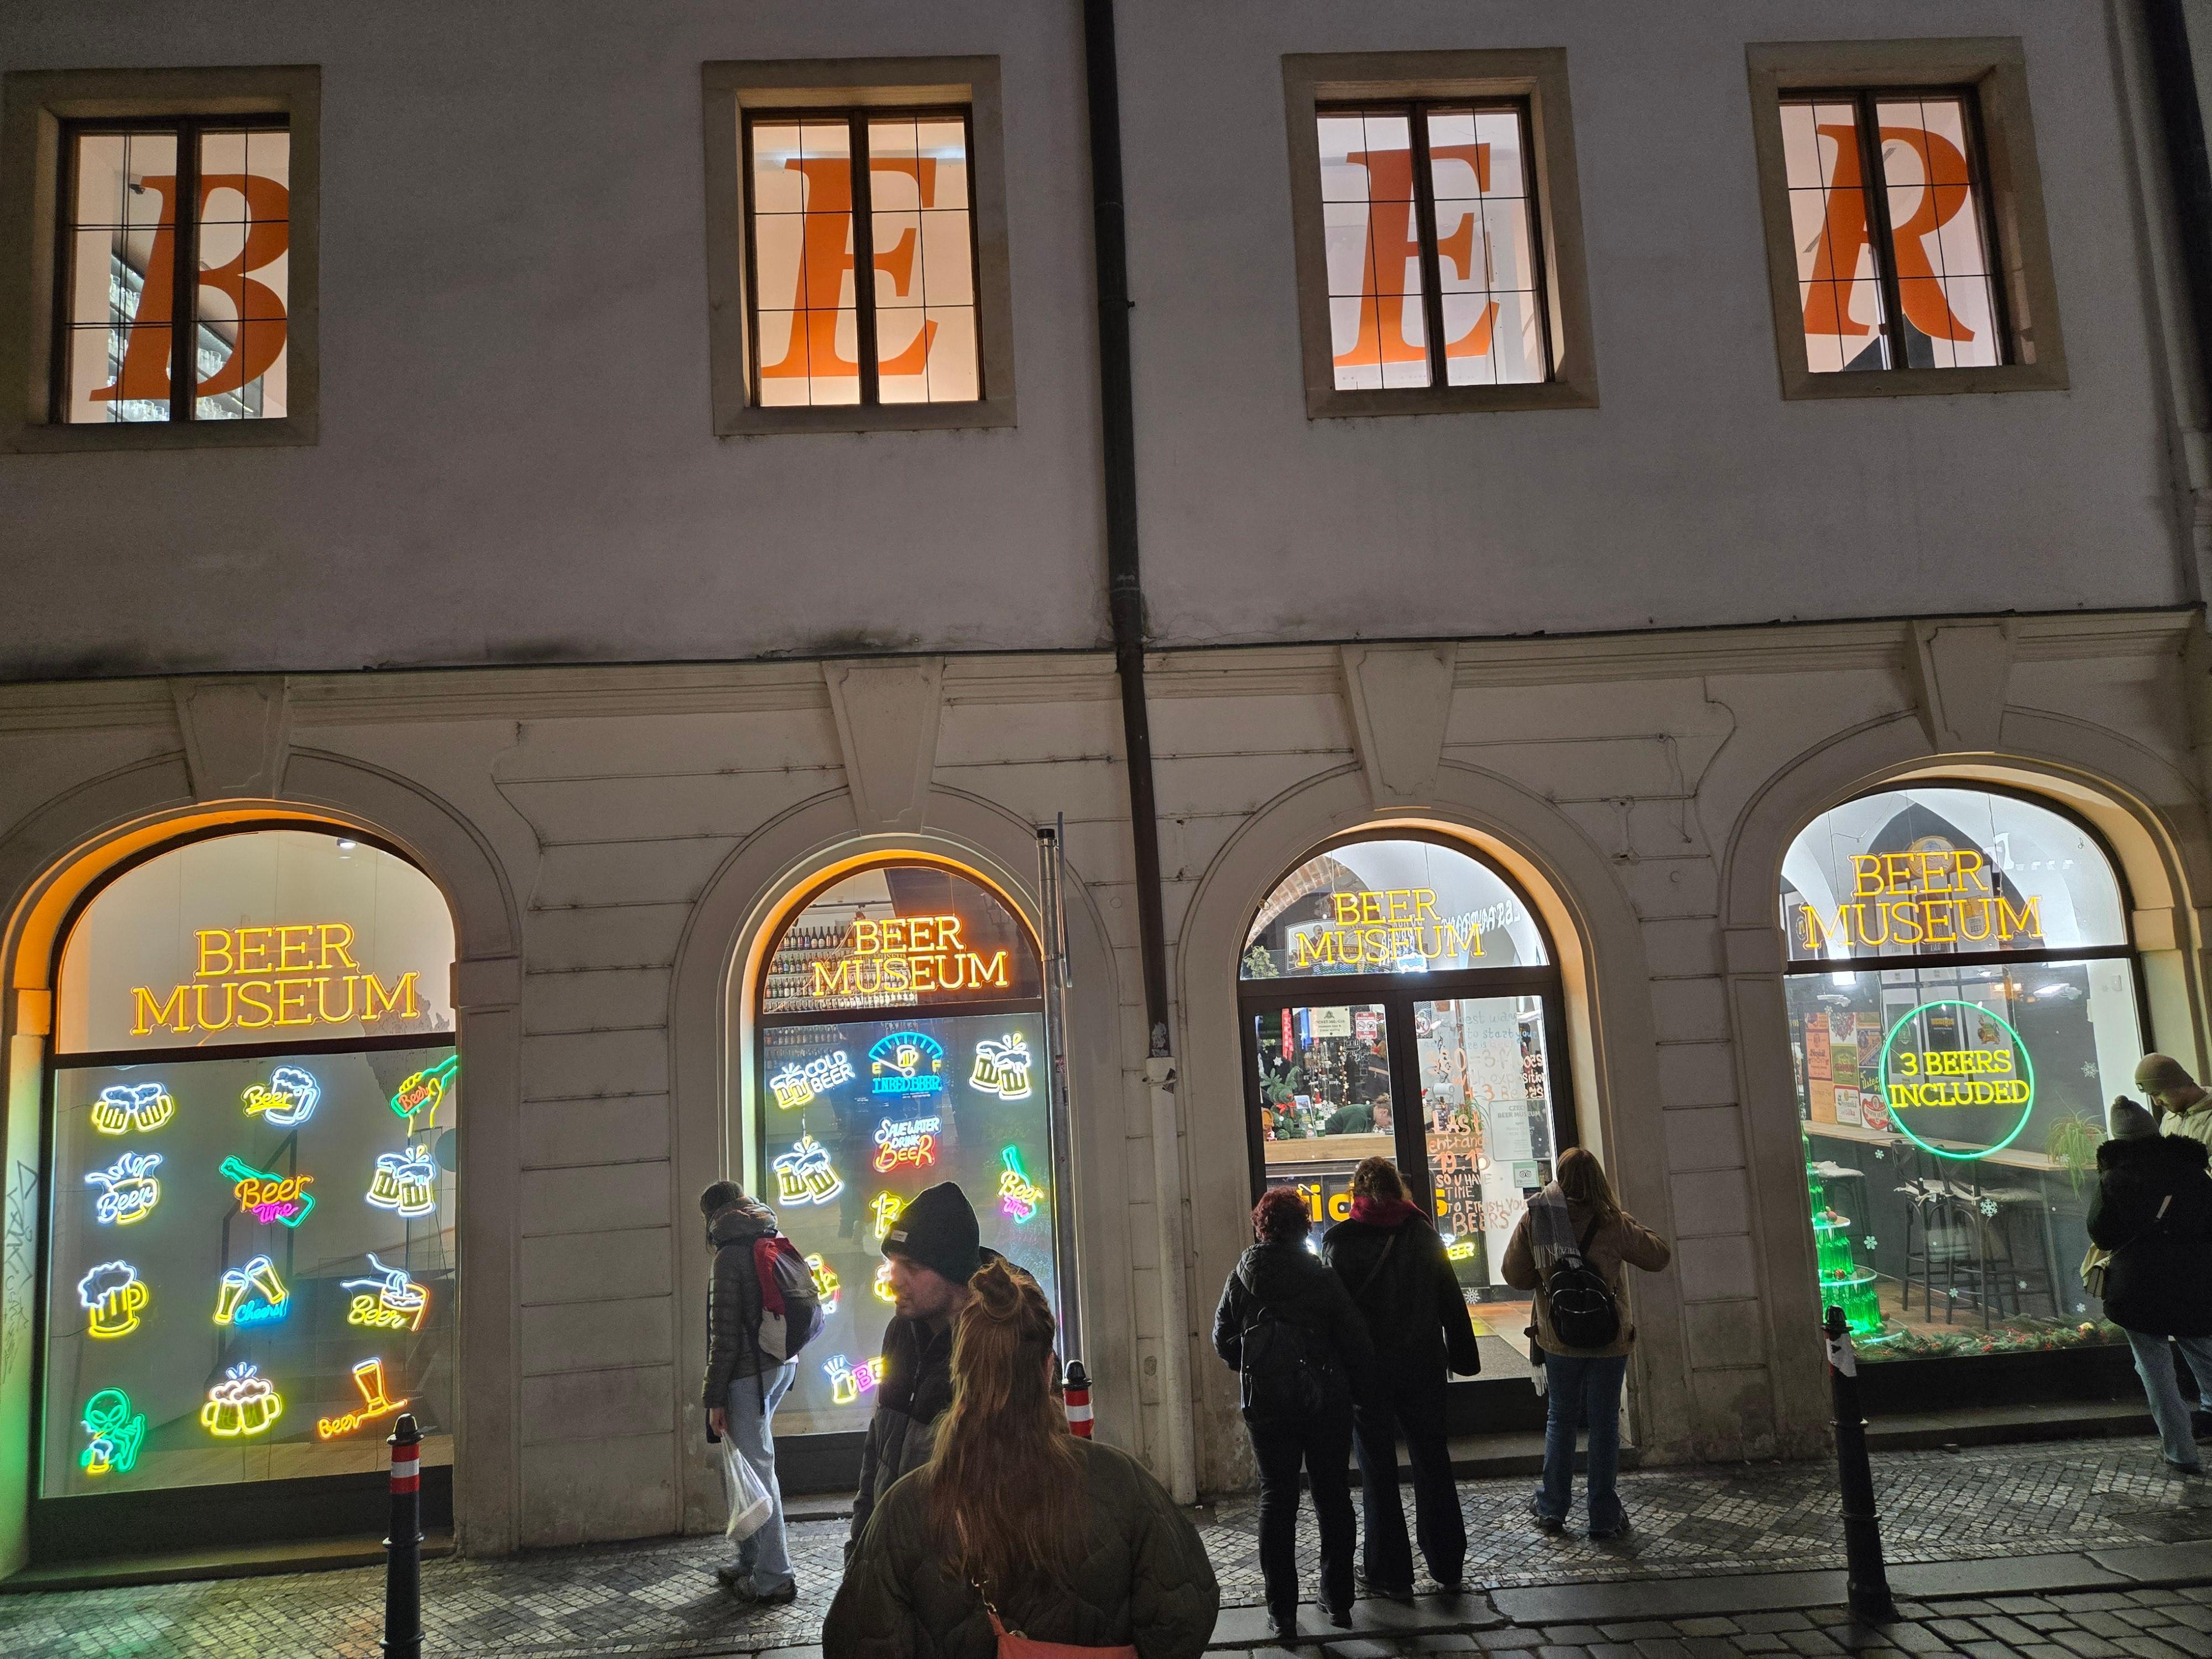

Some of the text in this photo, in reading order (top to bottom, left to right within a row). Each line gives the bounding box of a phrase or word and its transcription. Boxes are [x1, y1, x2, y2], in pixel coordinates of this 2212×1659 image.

[89, 124, 1975, 401] B E E R
[1848, 851, 1989, 897] BEER
[1333, 888, 1441, 927] BEER
[1801, 895, 2046, 948] MUSEUM
[195, 924, 357, 977] BEER
[853, 915, 964, 955] BEER
[1295, 924, 1485, 968] MUSEUM
[812, 951, 1008, 997] MUSEUM
[132, 972, 420, 1036] MUSEUM
[805, 1051, 847, 1078] COLD
[810, 1063, 855, 1093] BEER
[1900, 1049, 2012, 1076] 3 BEERS
[243, 1086, 293, 1105] Beer
[398, 1086, 430, 1111] Beer
[1887, 1079, 2030, 1107] INCLUDED
[875, 1117, 940, 1143] SAVE WATER
[891, 1134, 920, 1149] DRINK
[875, 1135, 932, 1169] BEER
[98, 1185, 154, 1222] Beer
[236, 1175, 313, 1212] Beer
[998, 1170, 1044, 1206] Beer
[1444, 1186, 1475, 1201] TIME
[1452, 1209, 1511, 1237] BEERS
[349, 1295, 408, 1329] Beer
[318, 1413, 359, 1439] Beer
